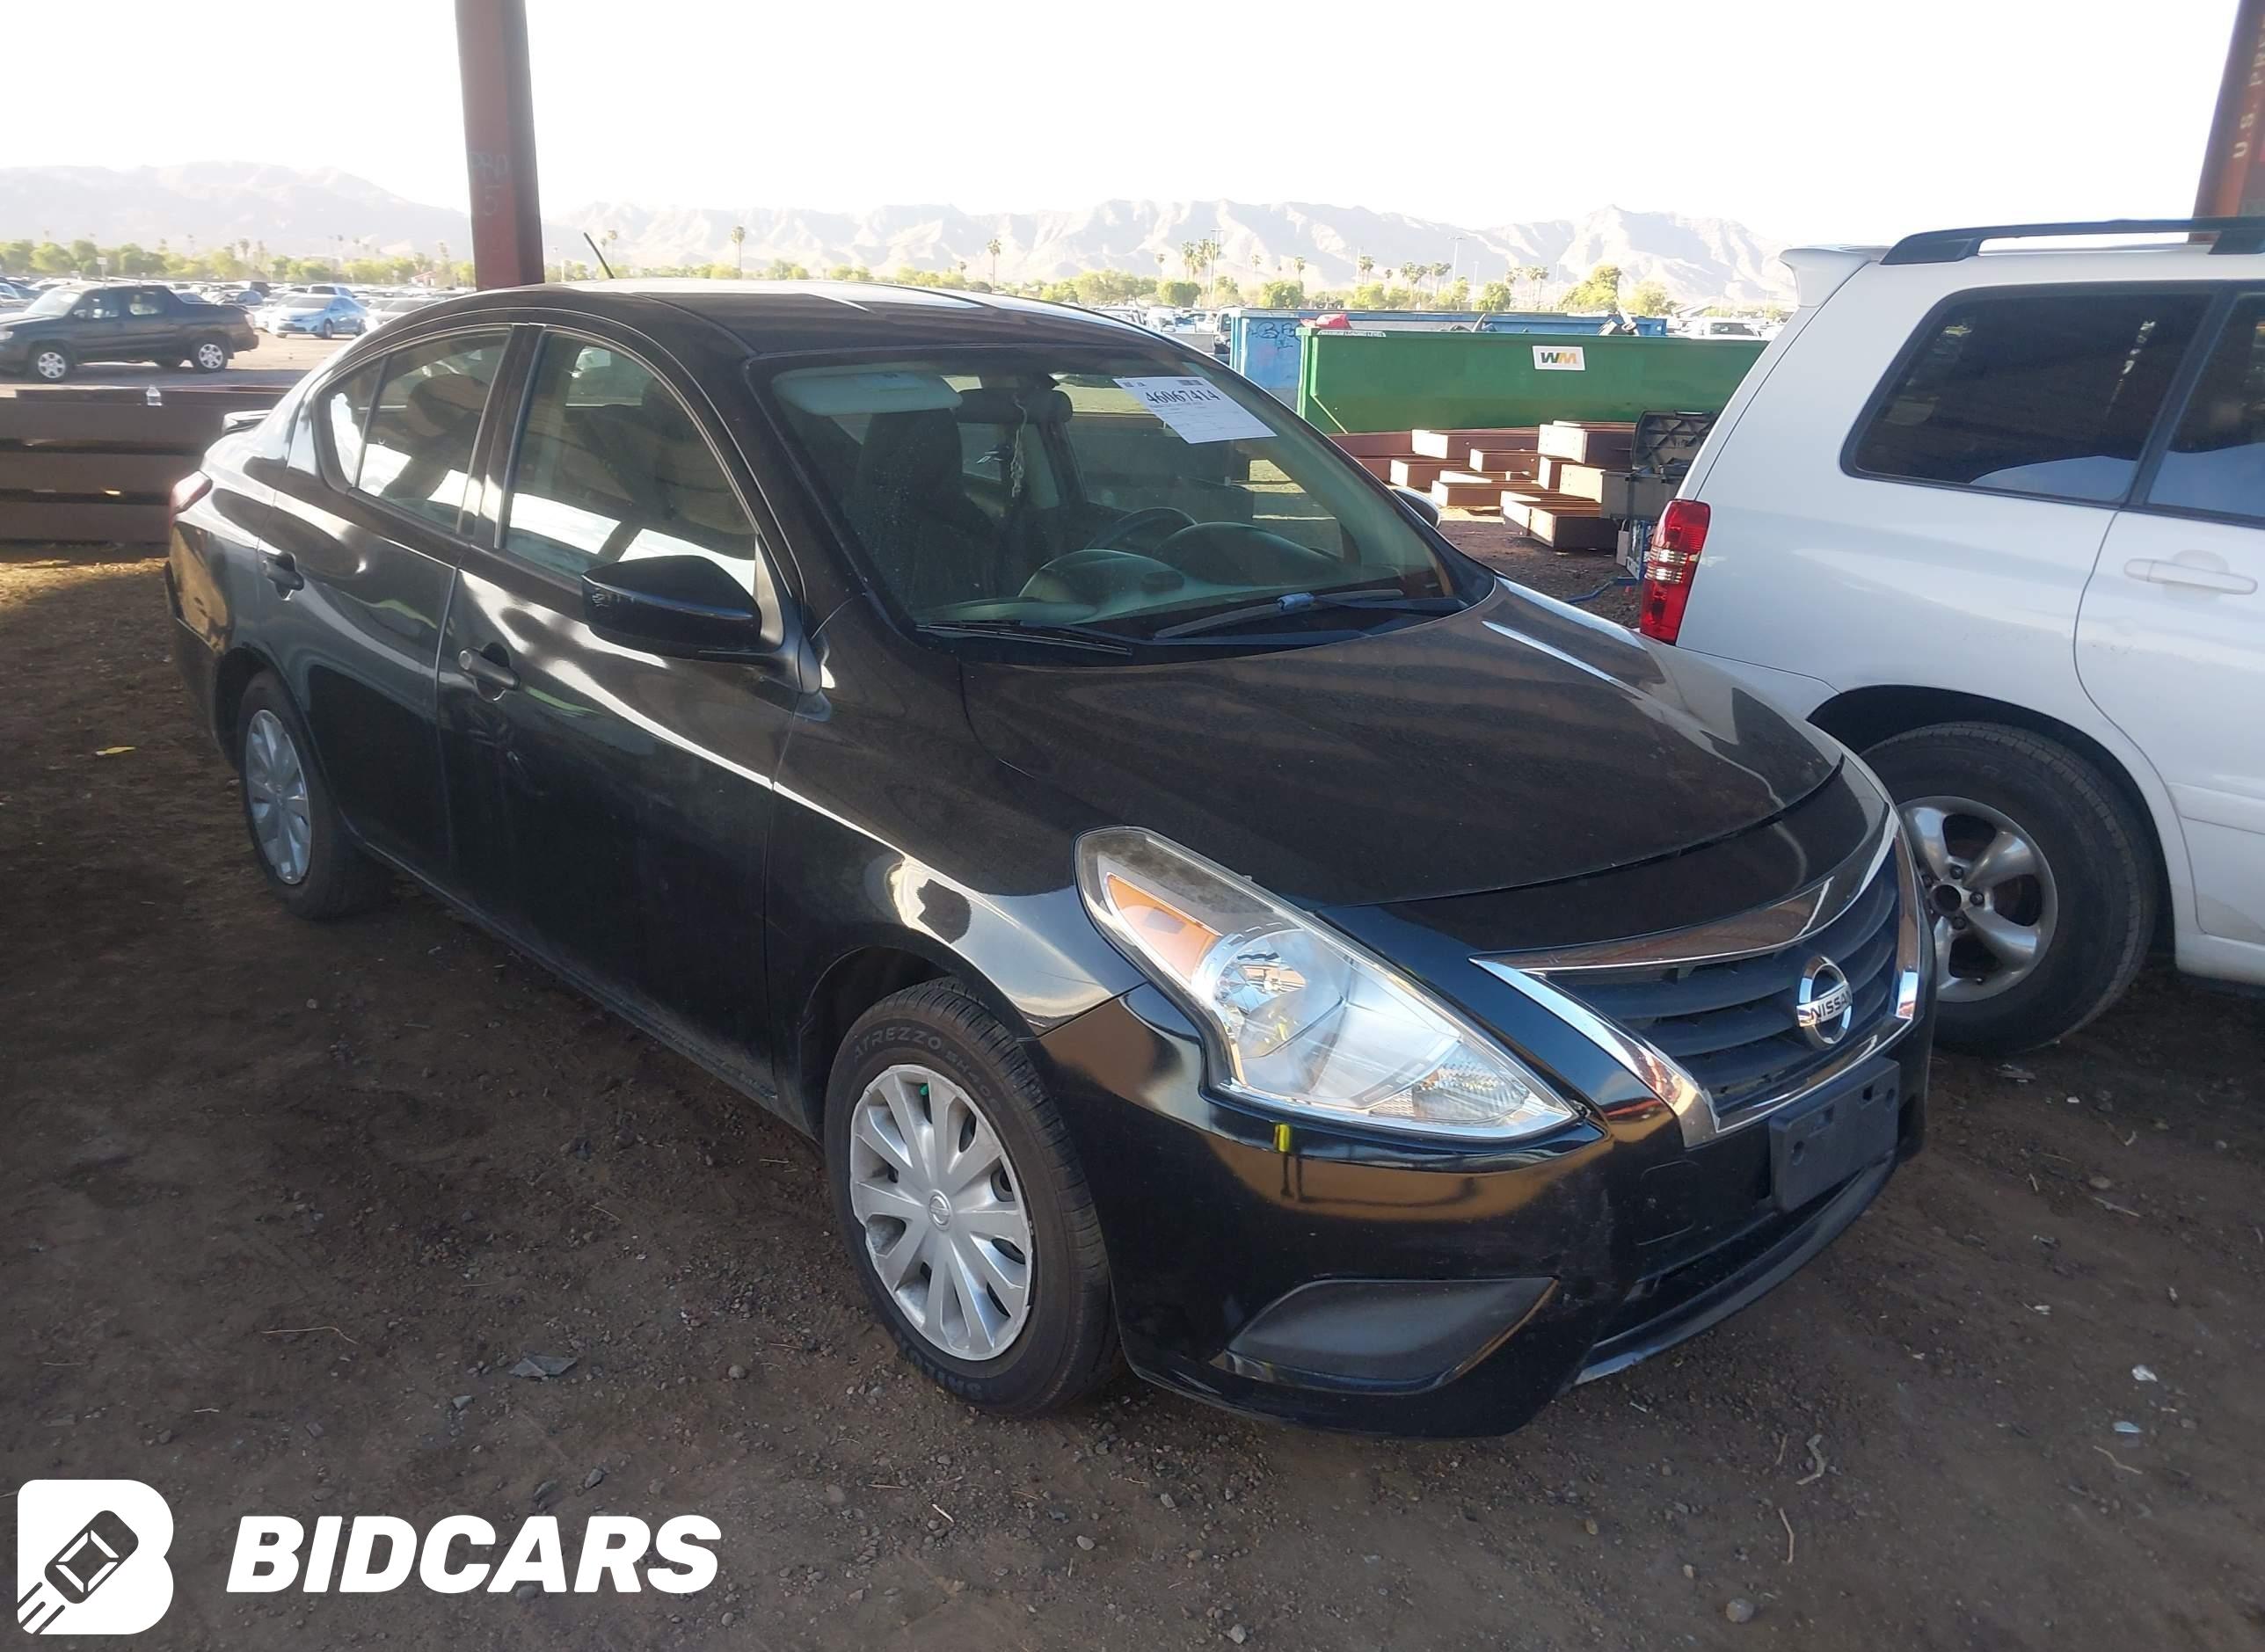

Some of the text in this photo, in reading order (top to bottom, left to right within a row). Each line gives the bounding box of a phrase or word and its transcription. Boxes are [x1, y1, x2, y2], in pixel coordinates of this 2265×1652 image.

[1540, 352, 1577, 364] WM
[1145, 389, 1221, 404] 46067414
[1810, 990, 1852, 1021] NISSAN
